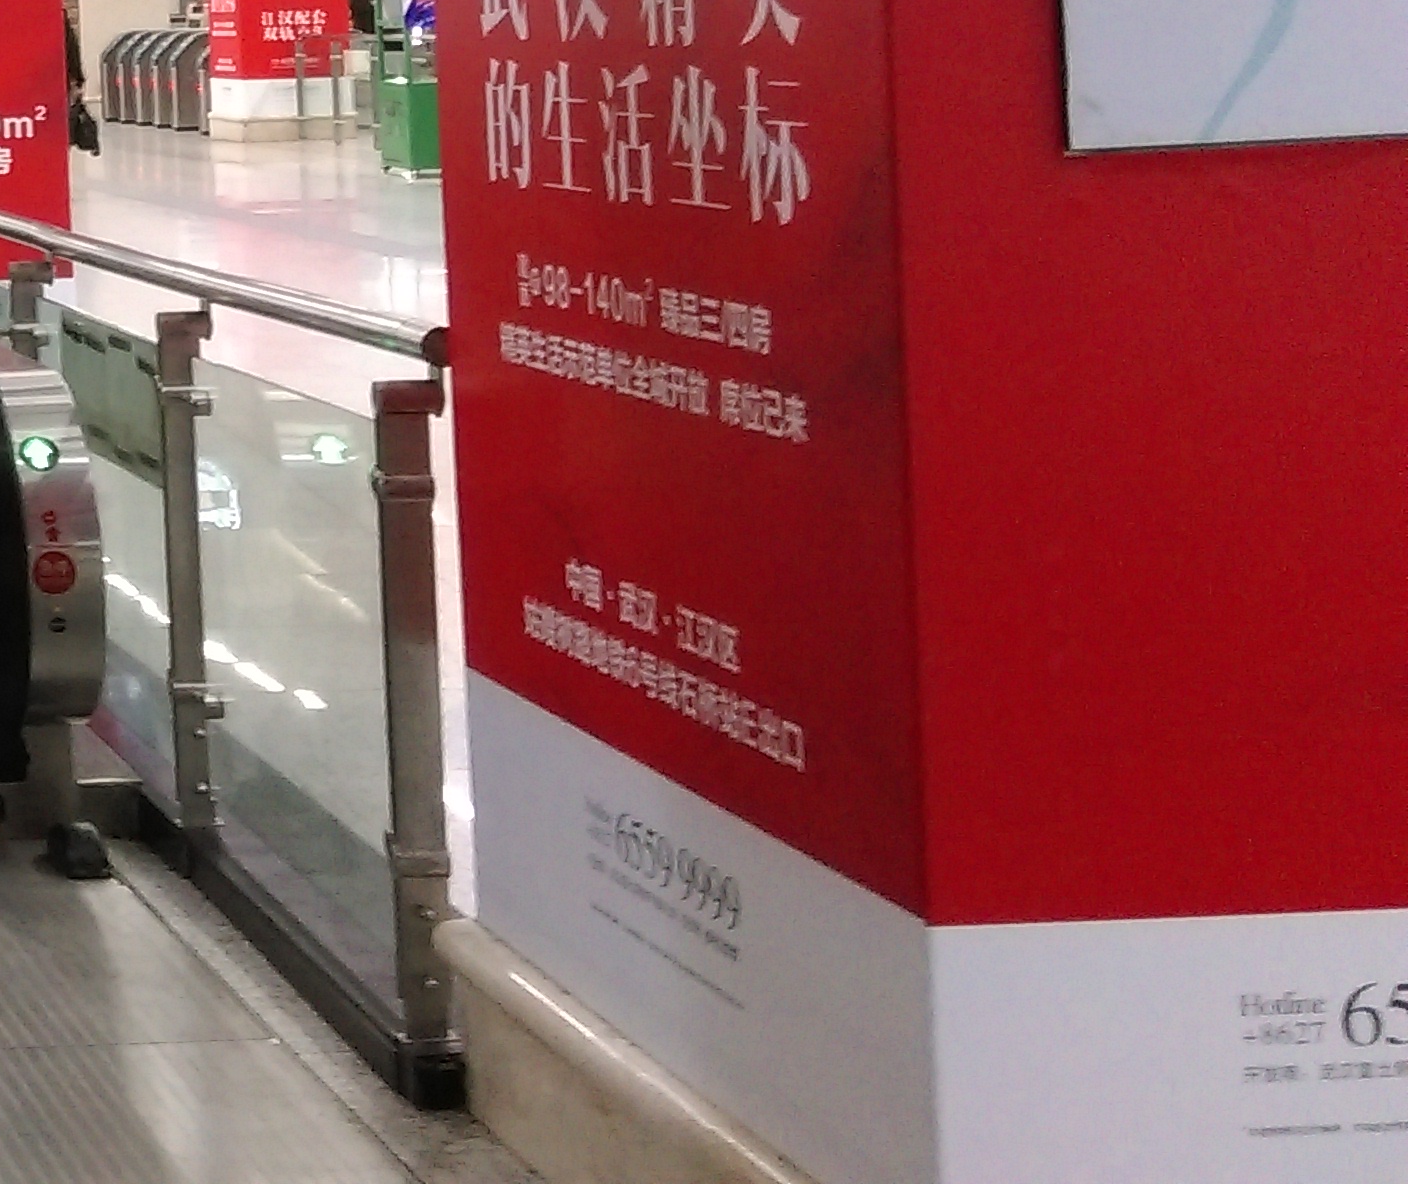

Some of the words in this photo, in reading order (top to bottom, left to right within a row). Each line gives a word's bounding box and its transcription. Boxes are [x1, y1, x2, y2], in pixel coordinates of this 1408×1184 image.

[485, 58, 811, 225] 的生活坐标
